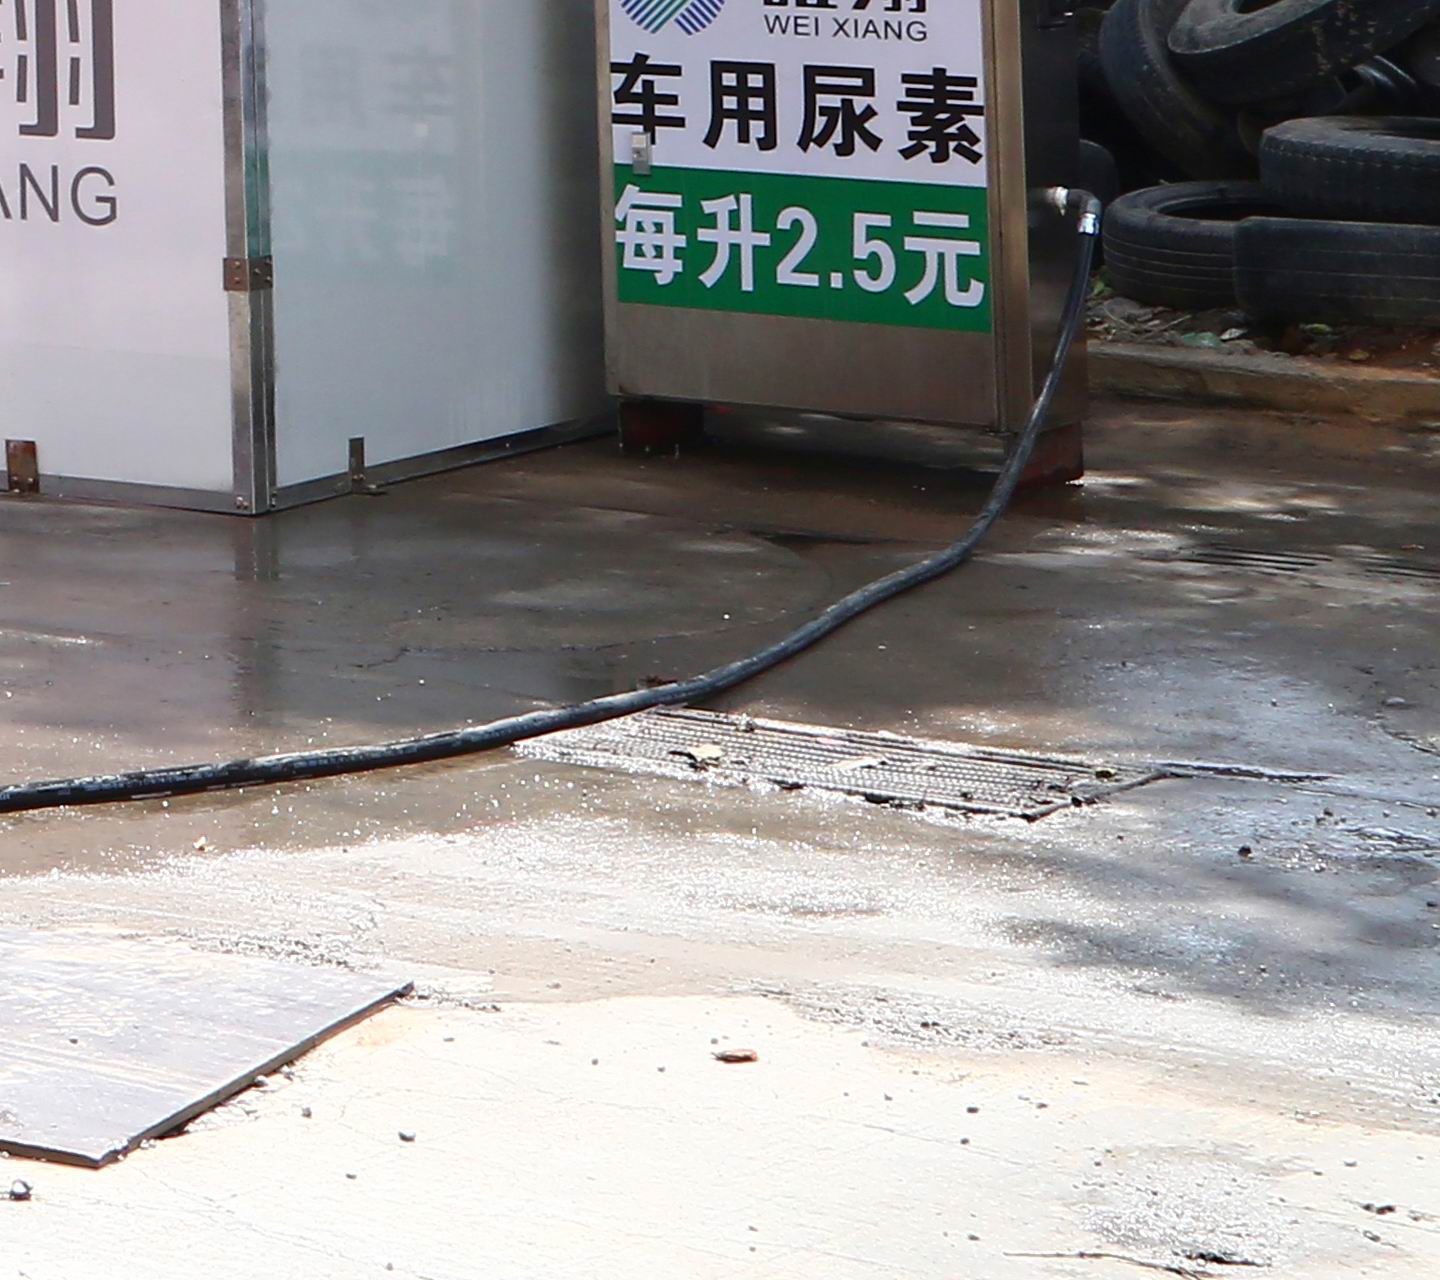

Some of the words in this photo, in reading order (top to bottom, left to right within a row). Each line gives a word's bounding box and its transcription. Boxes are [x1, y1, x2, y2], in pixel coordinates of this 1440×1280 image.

[763, 12, 822, 40] WEI
[830, 15, 930, 43] XIANG
[610, 52, 986, 166] 车用尿素
[615, 181, 986, 308] 每升2.5元
